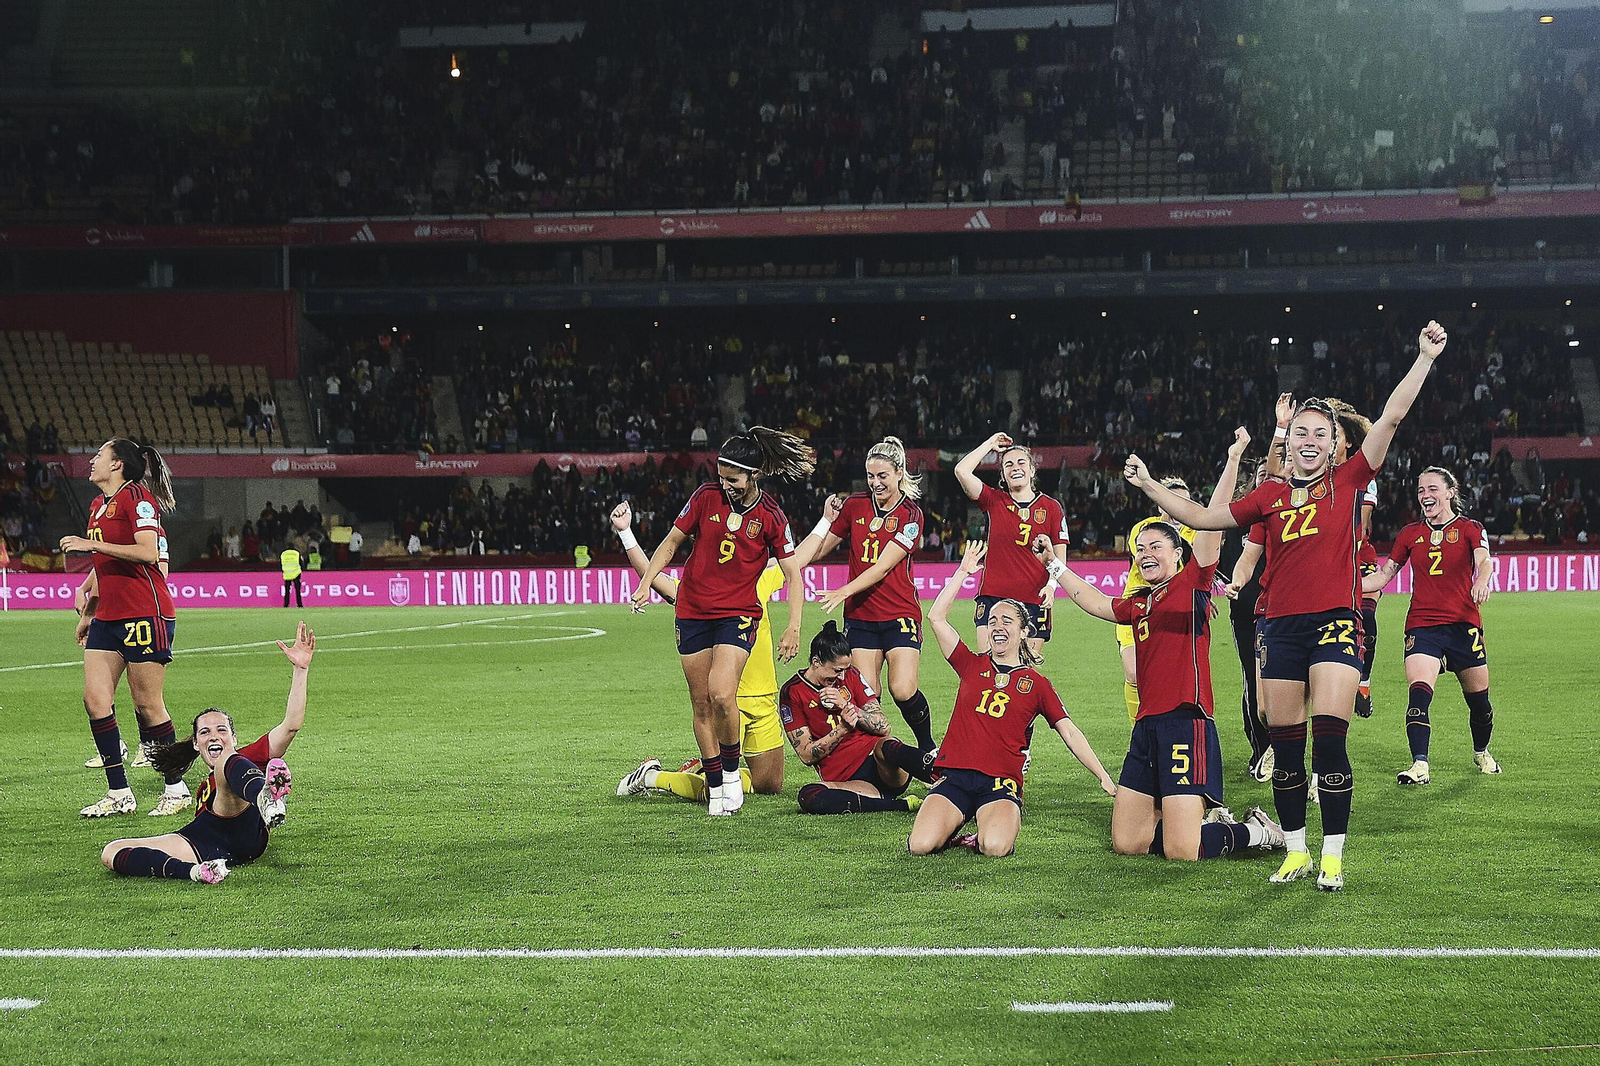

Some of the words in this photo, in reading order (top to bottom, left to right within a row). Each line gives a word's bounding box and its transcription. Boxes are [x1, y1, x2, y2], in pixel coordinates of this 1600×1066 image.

[1015, 522, 1032, 546] 3
[1279, 502, 1320, 543] 22
[718, 539, 736, 564] 9
[861, 538, 880, 564] 11
[1428, 551, 1444, 576] 2
[0, 583, 80, 599] ECCIÓ
[168, 582, 228, 598] ÑOLA
[239, 585, 269, 598] DE
[123, 620, 152, 647] 20
[897, 617, 917, 634] 11
[1137, 616, 1151, 642] 5
[1317, 619, 1356, 645] 22
[1468, 627, 1482, 652] 2
[975, 688, 1011, 718] 18
[1171, 743, 1190, 774] 5
